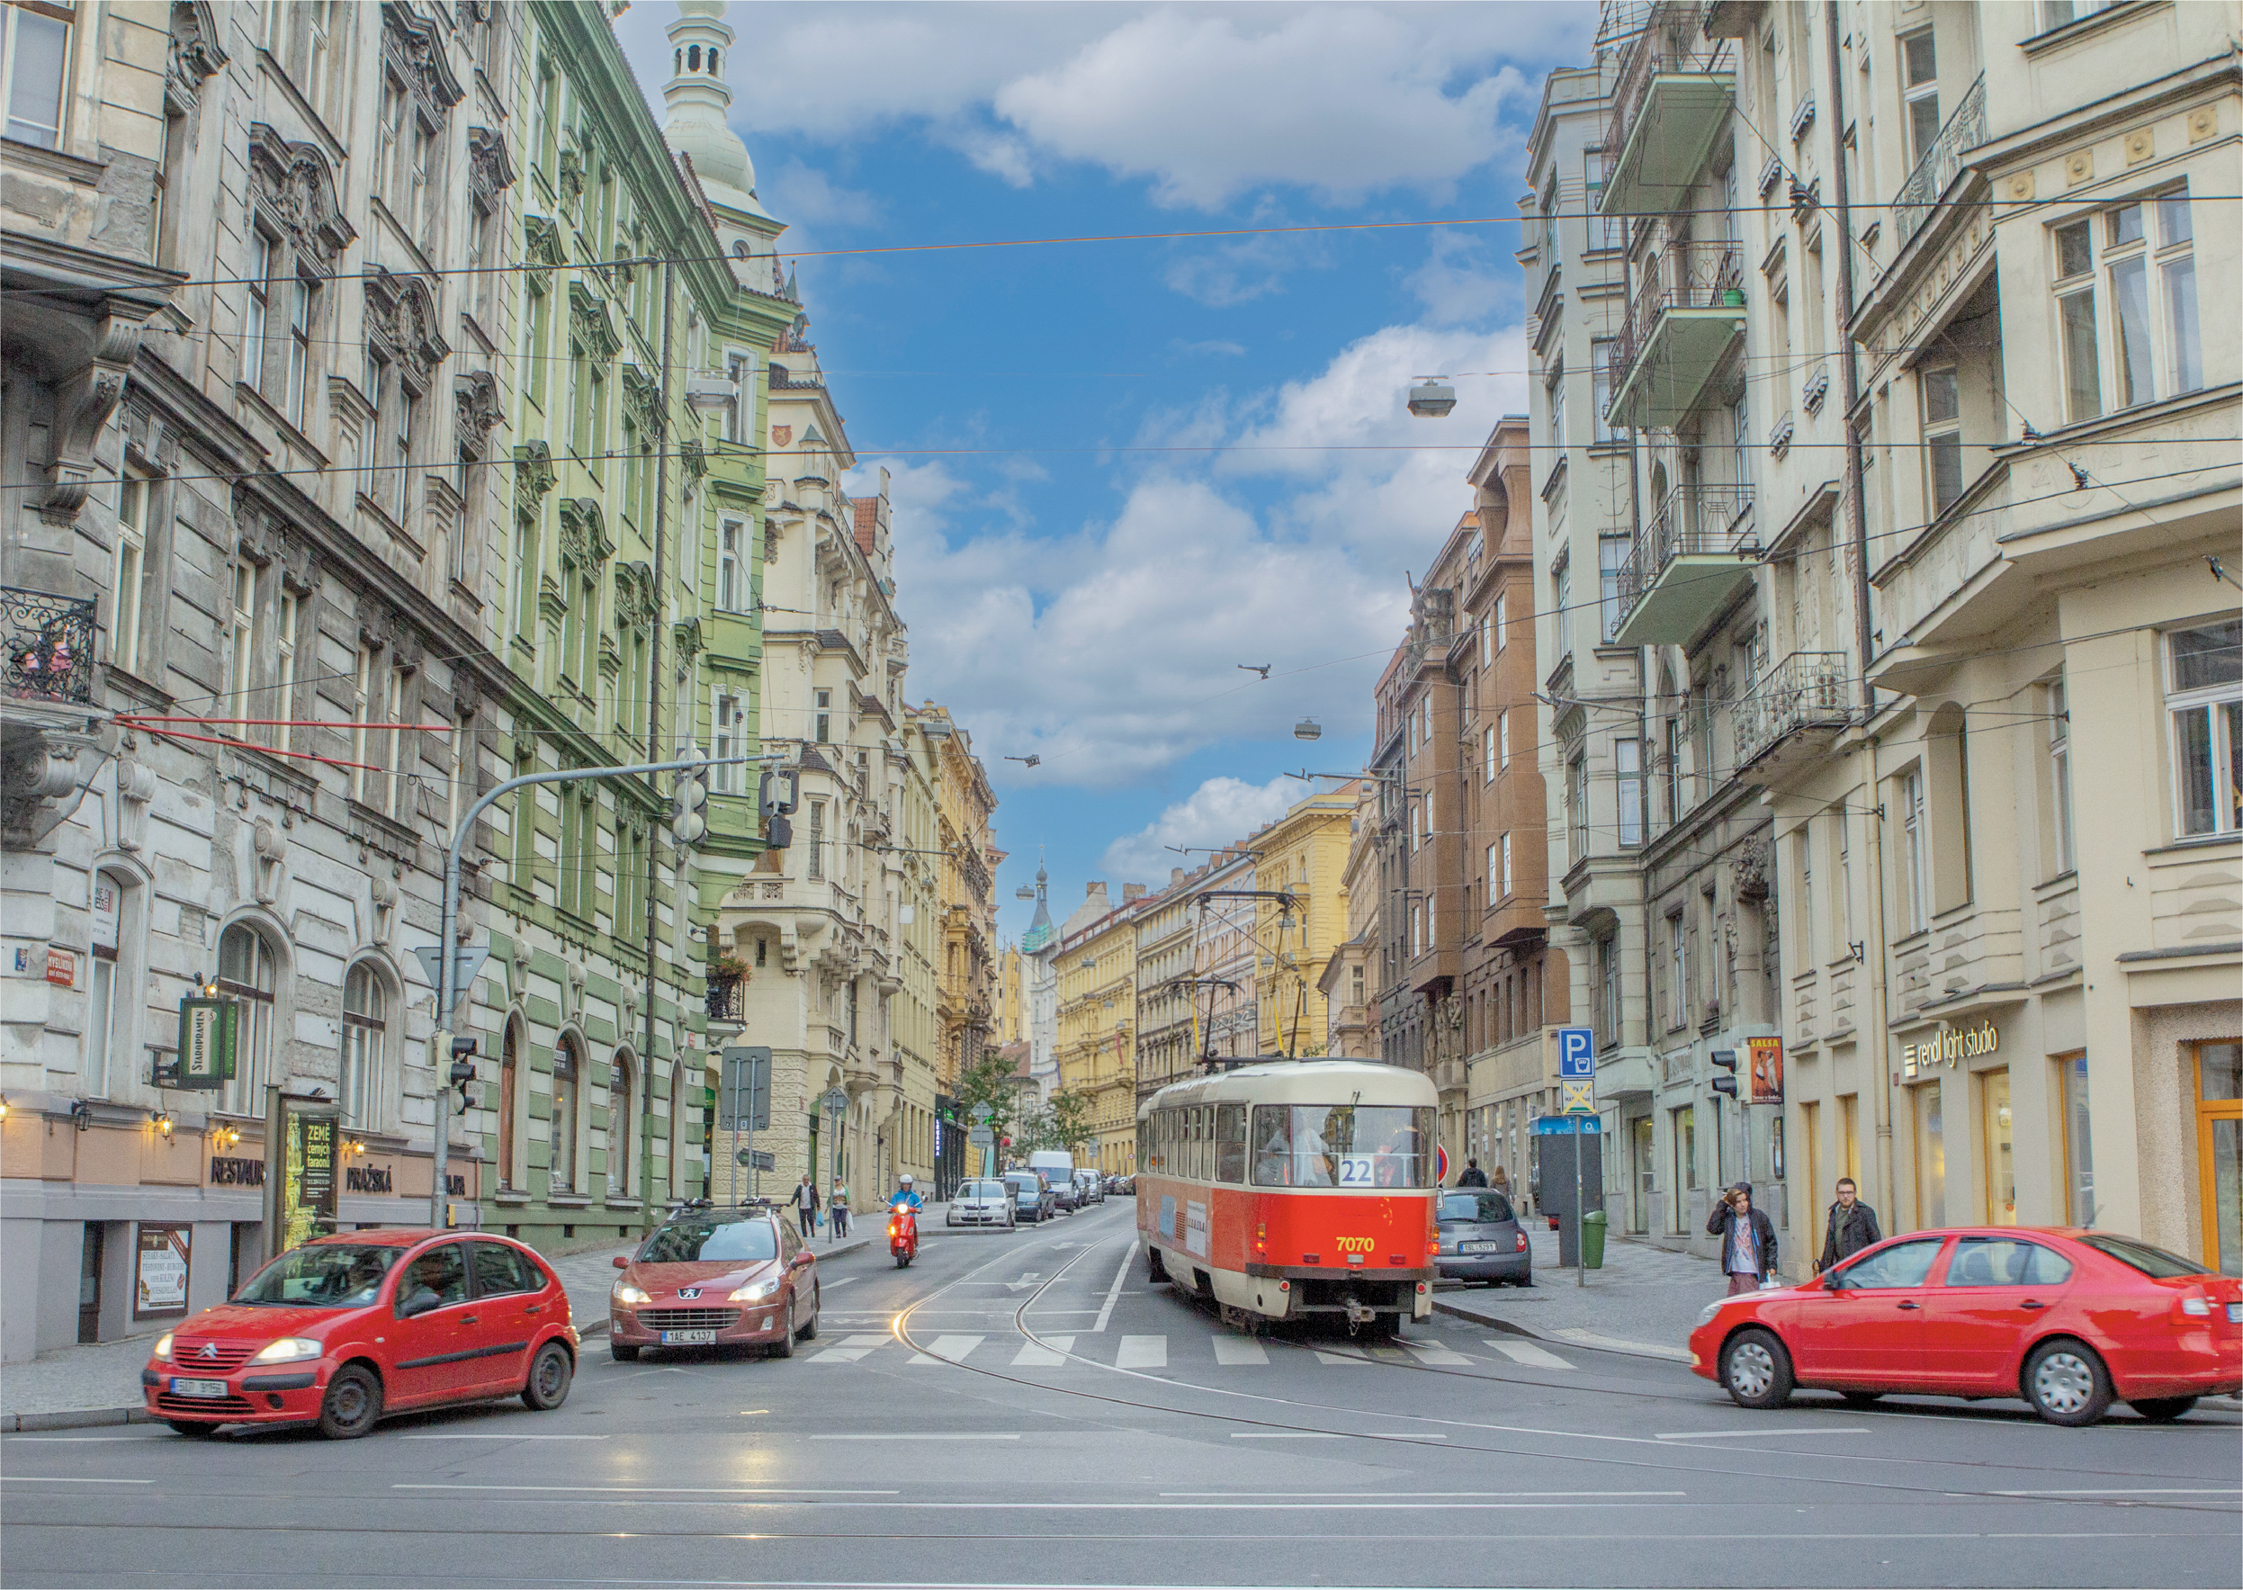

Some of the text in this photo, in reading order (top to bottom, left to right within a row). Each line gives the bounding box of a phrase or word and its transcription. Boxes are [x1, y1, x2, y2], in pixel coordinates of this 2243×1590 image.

[1566, 1034, 1586, 1062] P
[1751, 1039, 1779, 1047] SALSA
[1918, 1020, 1997, 1068] rendl light studio
[307, 1122, 331, 1141] ZEMĚ
[211, 1156, 264, 1186] RESTAUR
[1341, 1160, 1372, 1182] 22
[1336, 1237, 1375, 1252] 7070
[670, 1331, 711, 1341] 1AE 4137
